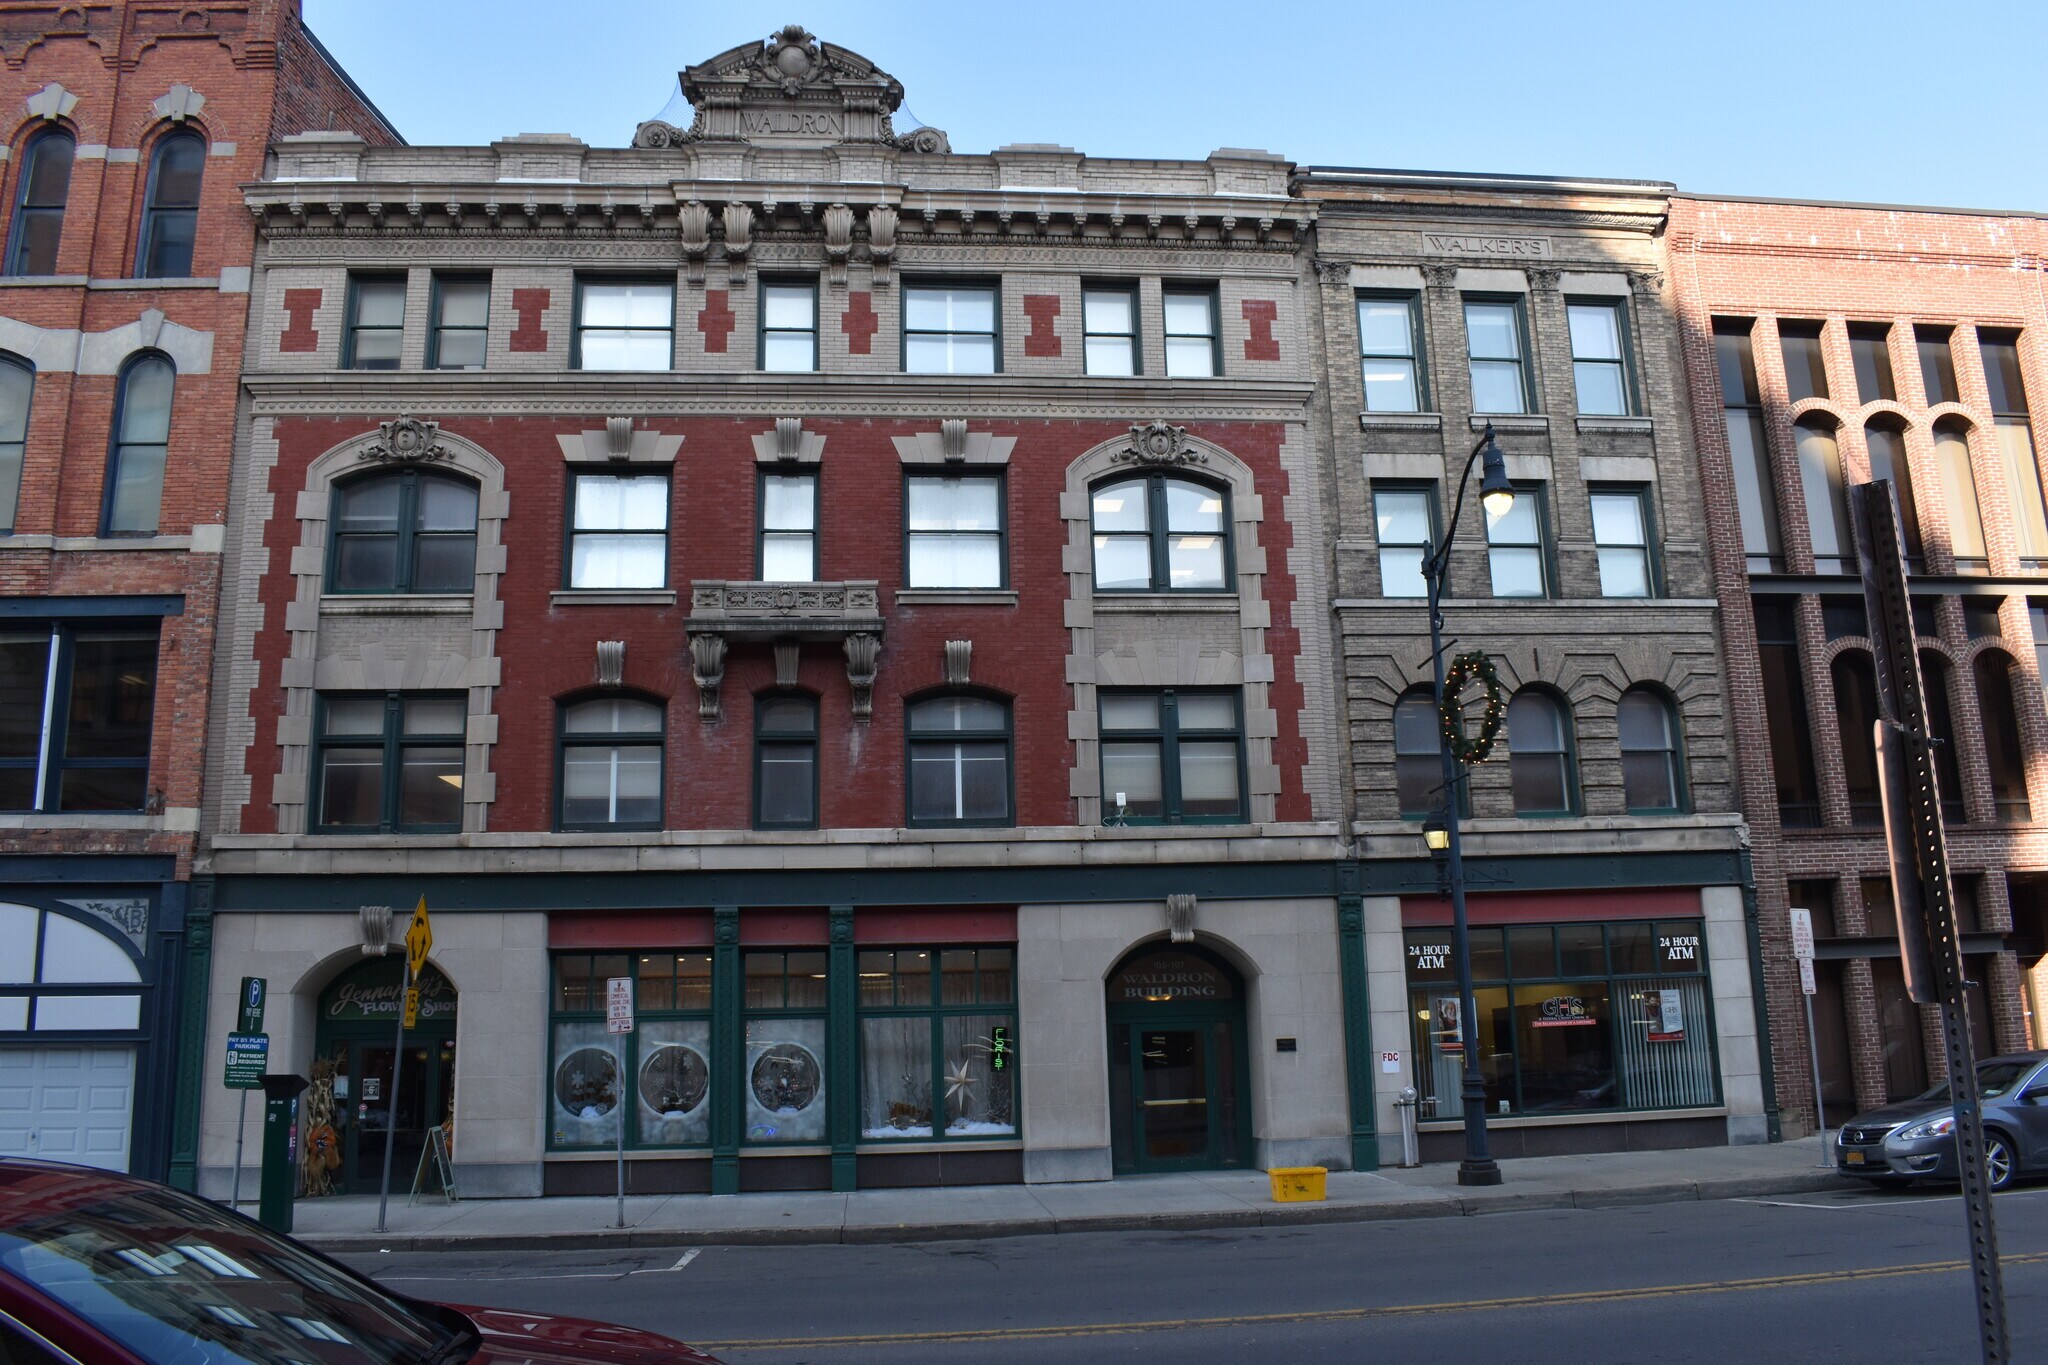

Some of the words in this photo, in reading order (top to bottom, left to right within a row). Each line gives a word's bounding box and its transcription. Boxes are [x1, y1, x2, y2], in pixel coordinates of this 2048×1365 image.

[741, 112, 843, 134] WALDRON
[1428, 236, 1543, 255] WALKER'S
[1659, 937, 1671, 947] 24
[1672, 936, 1699, 946] HOUR
[1409, 945, 1420, 956] 24
[1423, 944, 1451, 955] HOUR
[1667, 946, 1694, 960] ATM
[1153, 960, 1185, 969] 105-107
[1417, 955, 1445, 969] ATM
[1122, 972, 1216, 984] WALDRON
[1124, 985, 1216, 998] BUILDING
[408, 993, 416, 1013] 15
[1542, 996, 1584, 1017] GHS
[994, 1028, 1005, 1071] FLORIST
[1382, 1052, 1399, 1062] FDC
